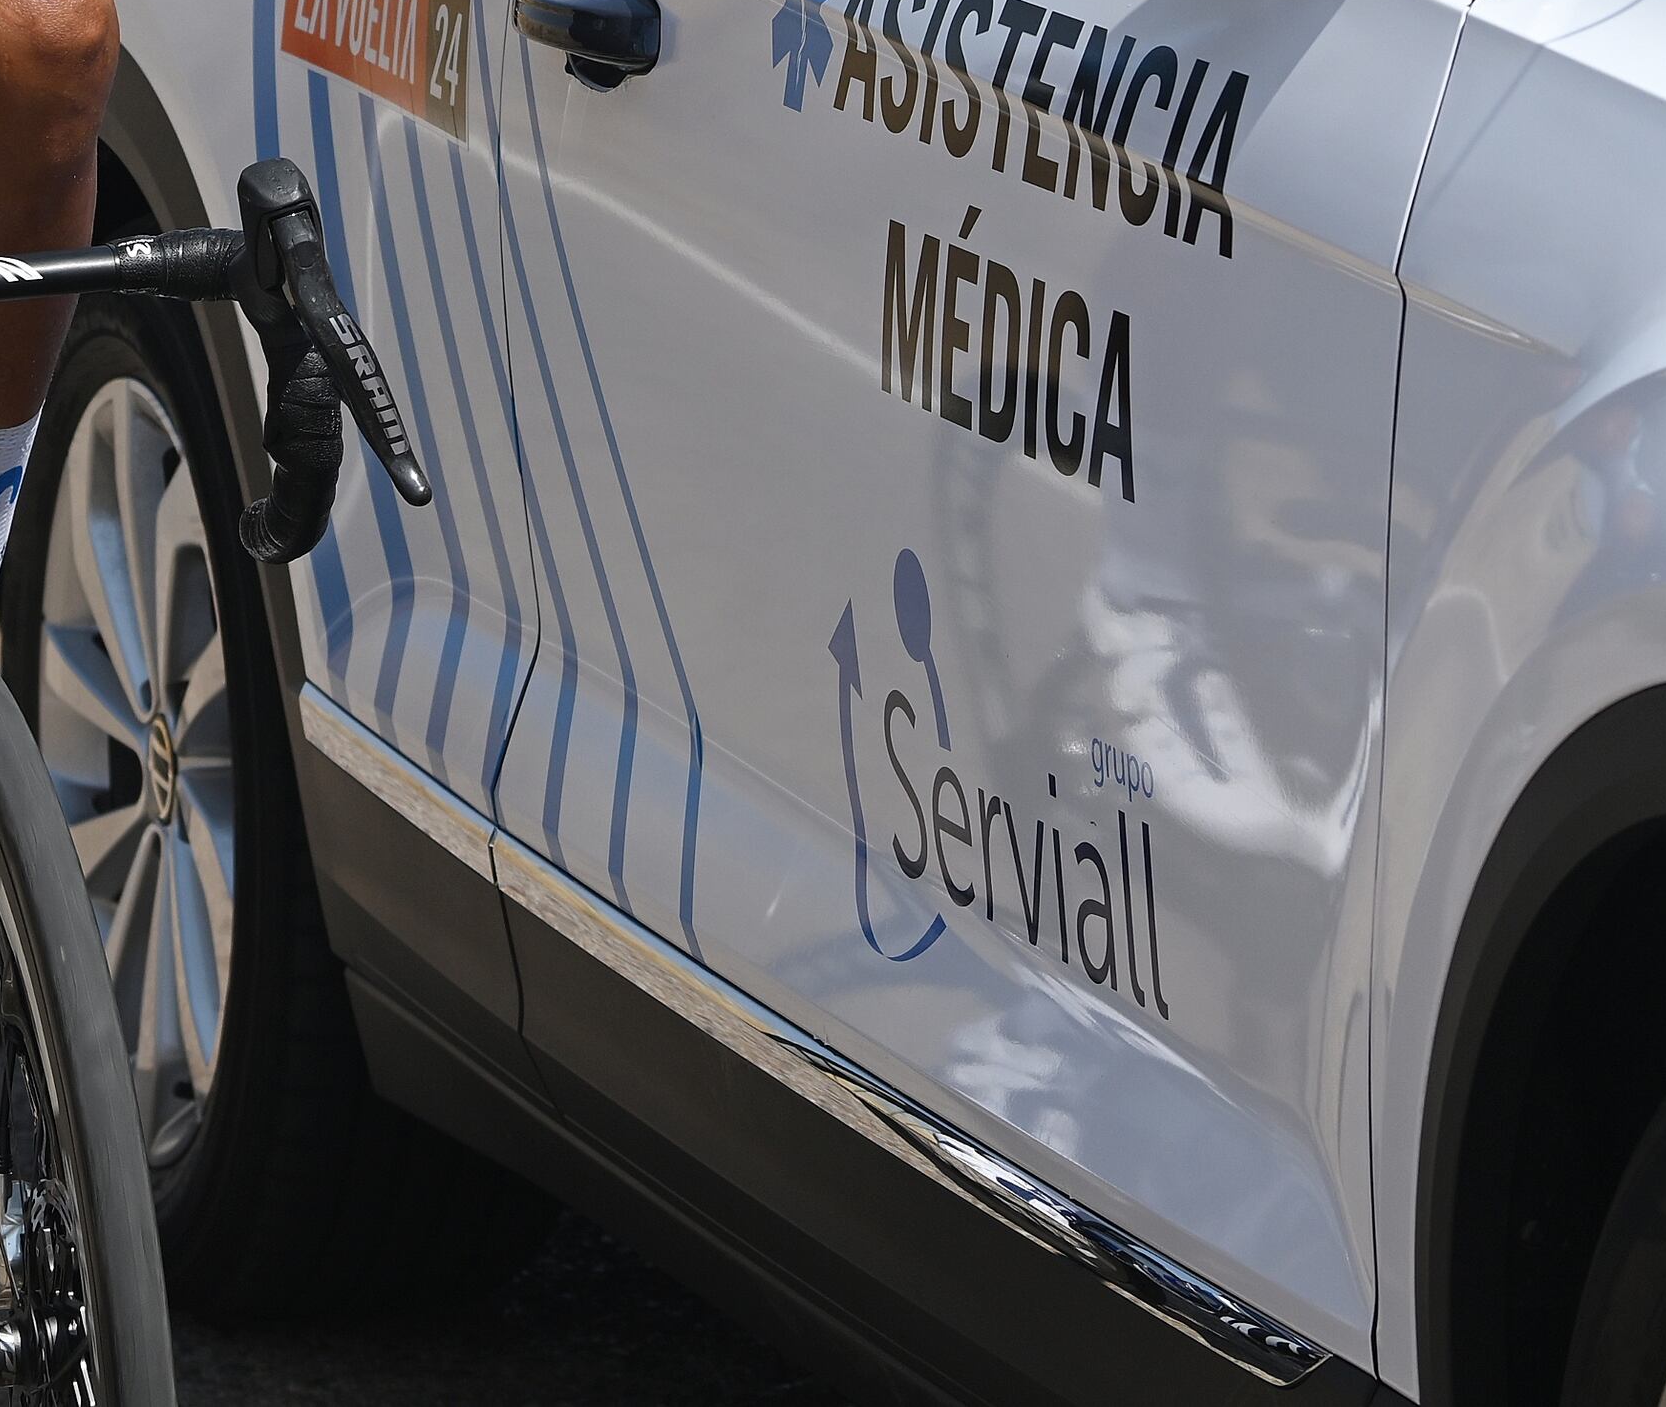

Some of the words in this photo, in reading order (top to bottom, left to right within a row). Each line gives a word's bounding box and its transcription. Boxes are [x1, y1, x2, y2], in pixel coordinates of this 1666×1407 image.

[429, 3, 463, 107] 24
[328, 313, 410, 456] SRAM
[881, 204, 1136, 504] MÉDICA
[1091, 737, 1155, 803] grupo
[883, 689, 1169, 1021] Serviall
